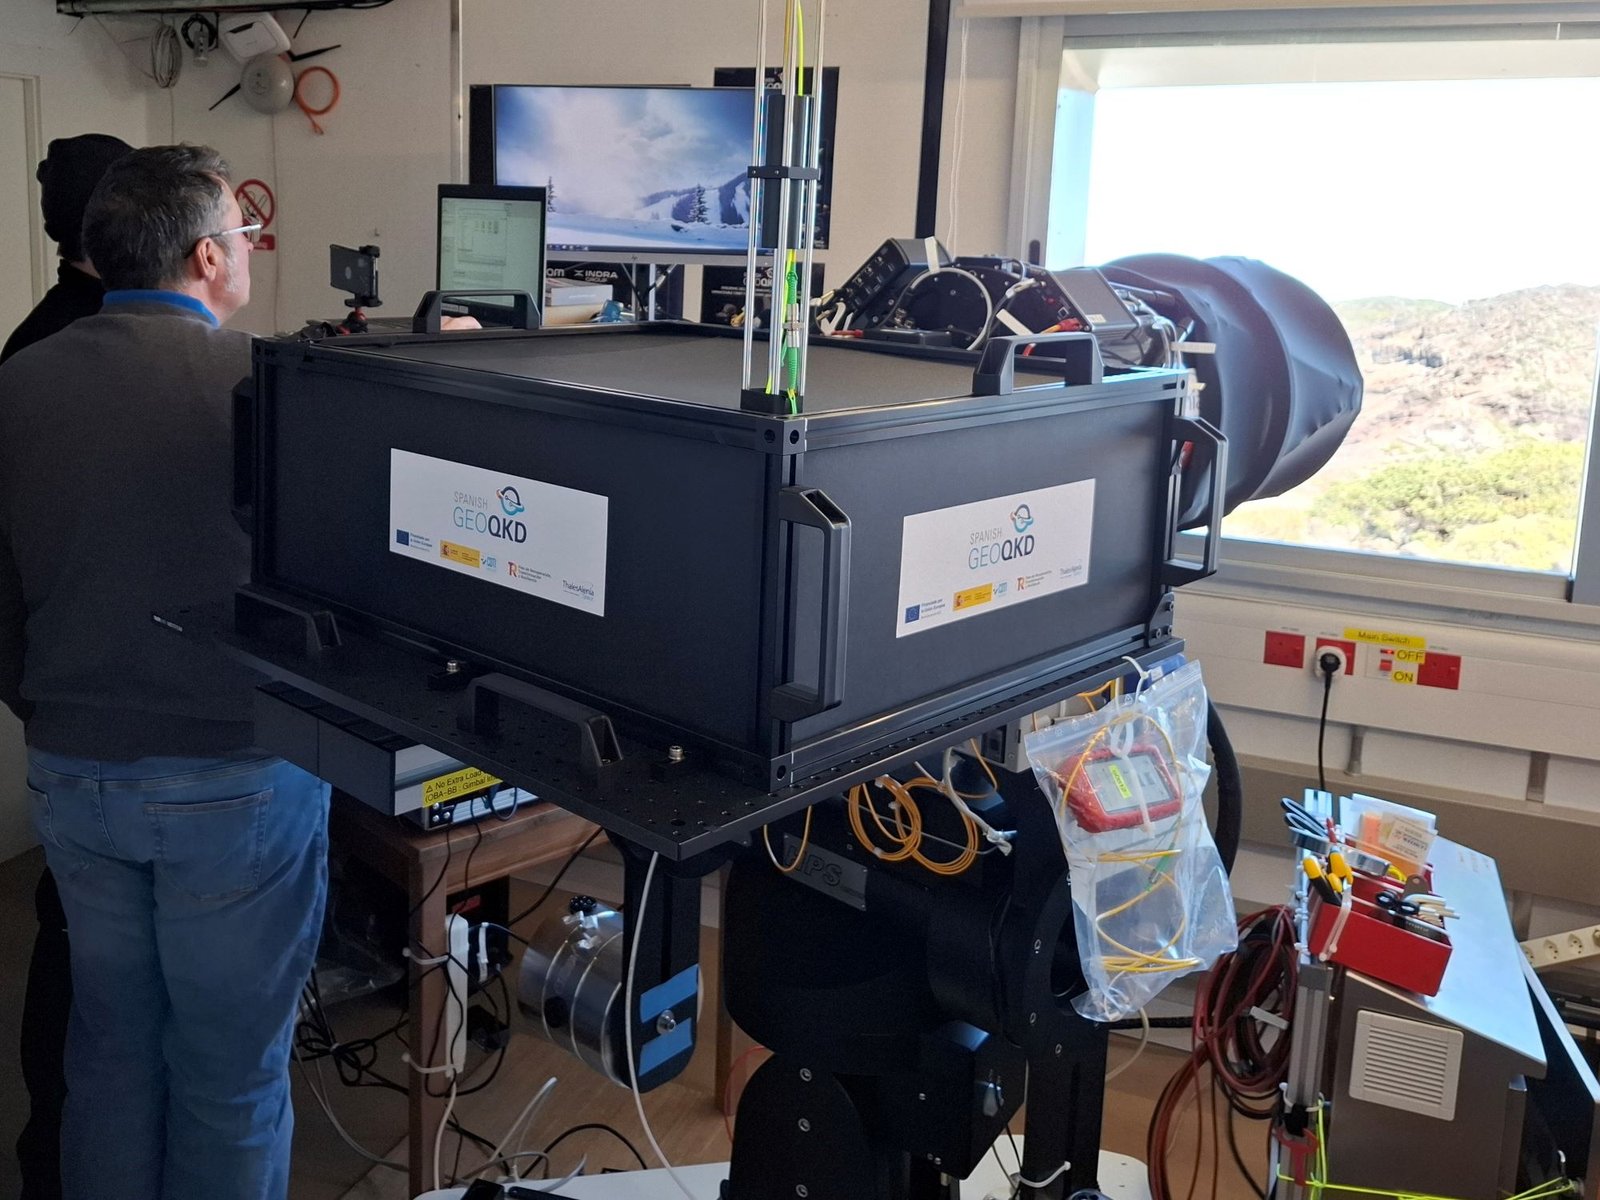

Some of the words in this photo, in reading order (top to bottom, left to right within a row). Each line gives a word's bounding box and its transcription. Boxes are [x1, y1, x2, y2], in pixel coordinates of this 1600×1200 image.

[585, 270, 618, 279] INDRA
[453, 490, 489, 510] SPANISH
[453, 506, 527, 544] GEOQKD
[969, 527, 1003, 545] SPANISH
[968, 534, 1035, 570] GEOQKD
[1358, 631, 1379, 640] Main
[1381, 633, 1410, 644] Switch
[1397, 649, 1425, 661] OFF
[1394, 670, 1413, 682] ON
[435, 782, 446, 790] No
[447, 776, 464, 786] Extra
